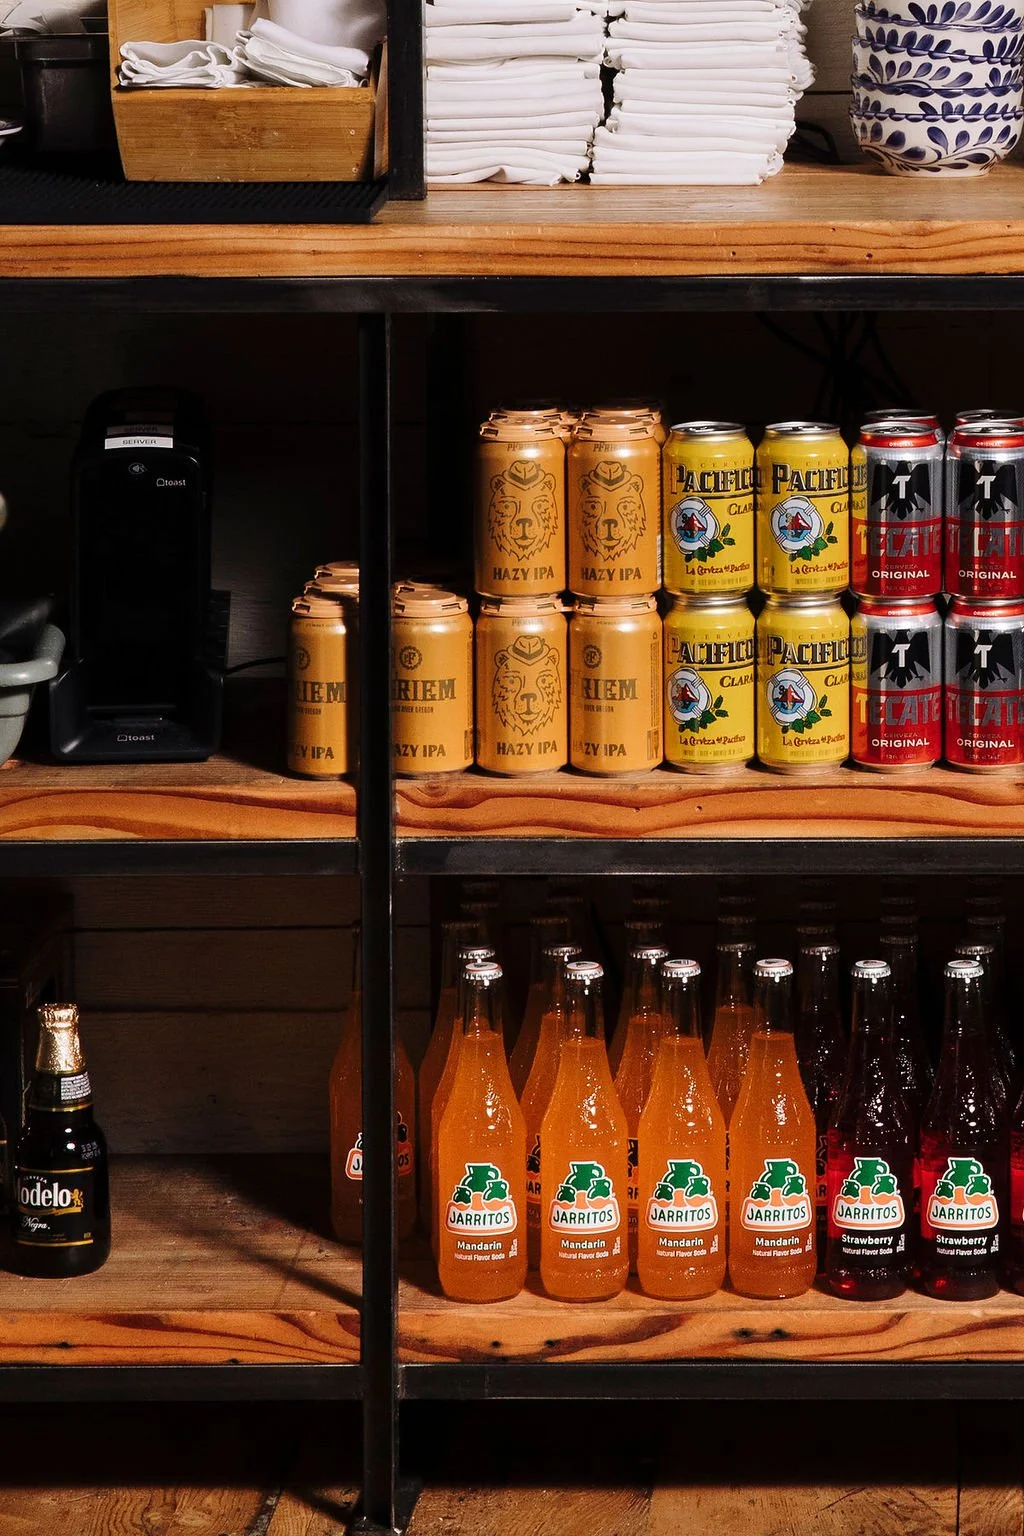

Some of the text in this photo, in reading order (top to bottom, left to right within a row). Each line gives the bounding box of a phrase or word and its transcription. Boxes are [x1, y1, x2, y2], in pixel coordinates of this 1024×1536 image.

[892, 476, 911, 499] T
[976, 476, 996, 499] T
[856, 524, 941, 557] TECATE
[494, 566, 554, 580] HAZY IPA
[581, 568, 641, 581] HAZY IPA
[697, 566, 723, 575] Cerveza
[802, 565, 827, 575] Cerveza
[872, 570, 930, 579] ORIGINAL
[959, 570, 1016, 579] ORIGINAL
[892, 644, 911, 667] T
[974, 645, 992, 668] T
[856, 691, 941, 725] TECATE
[497, 740, 557, 755] HAZY IPA
[690, 736, 716, 746] Cerveza
[794, 737, 820, 746] Cerveza
[872, 738, 930, 748] ORIGINAL
[957, 738, 1014, 748] ORIGINAL
[311, 746, 334, 759] IPA
[423, 744, 446, 757] IPA
[604, 744, 626, 756] IPA
[450, 1208, 510, 1226] JARRITOS
[553, 1209, 613, 1224] JARRITOS
[650, 1206, 711, 1222] JARRITOS
[747, 1205, 807, 1221] JARRITOS
[838, 1205, 898, 1220] JARRITOS
[931, 1205, 991, 1220] JARRITOS
[457, 1241, 502, 1250] Mandarin
[561, 1240, 605, 1249] Mandarin
[659, 1237, 703, 1247] Mandarin
[756, 1236, 799, 1246] Mandarin
[842, 1234, 893, 1245] Strawberry
[936, 1234, 987, 1246] Strawberry
[843, 1247, 861, 1255] Natural
